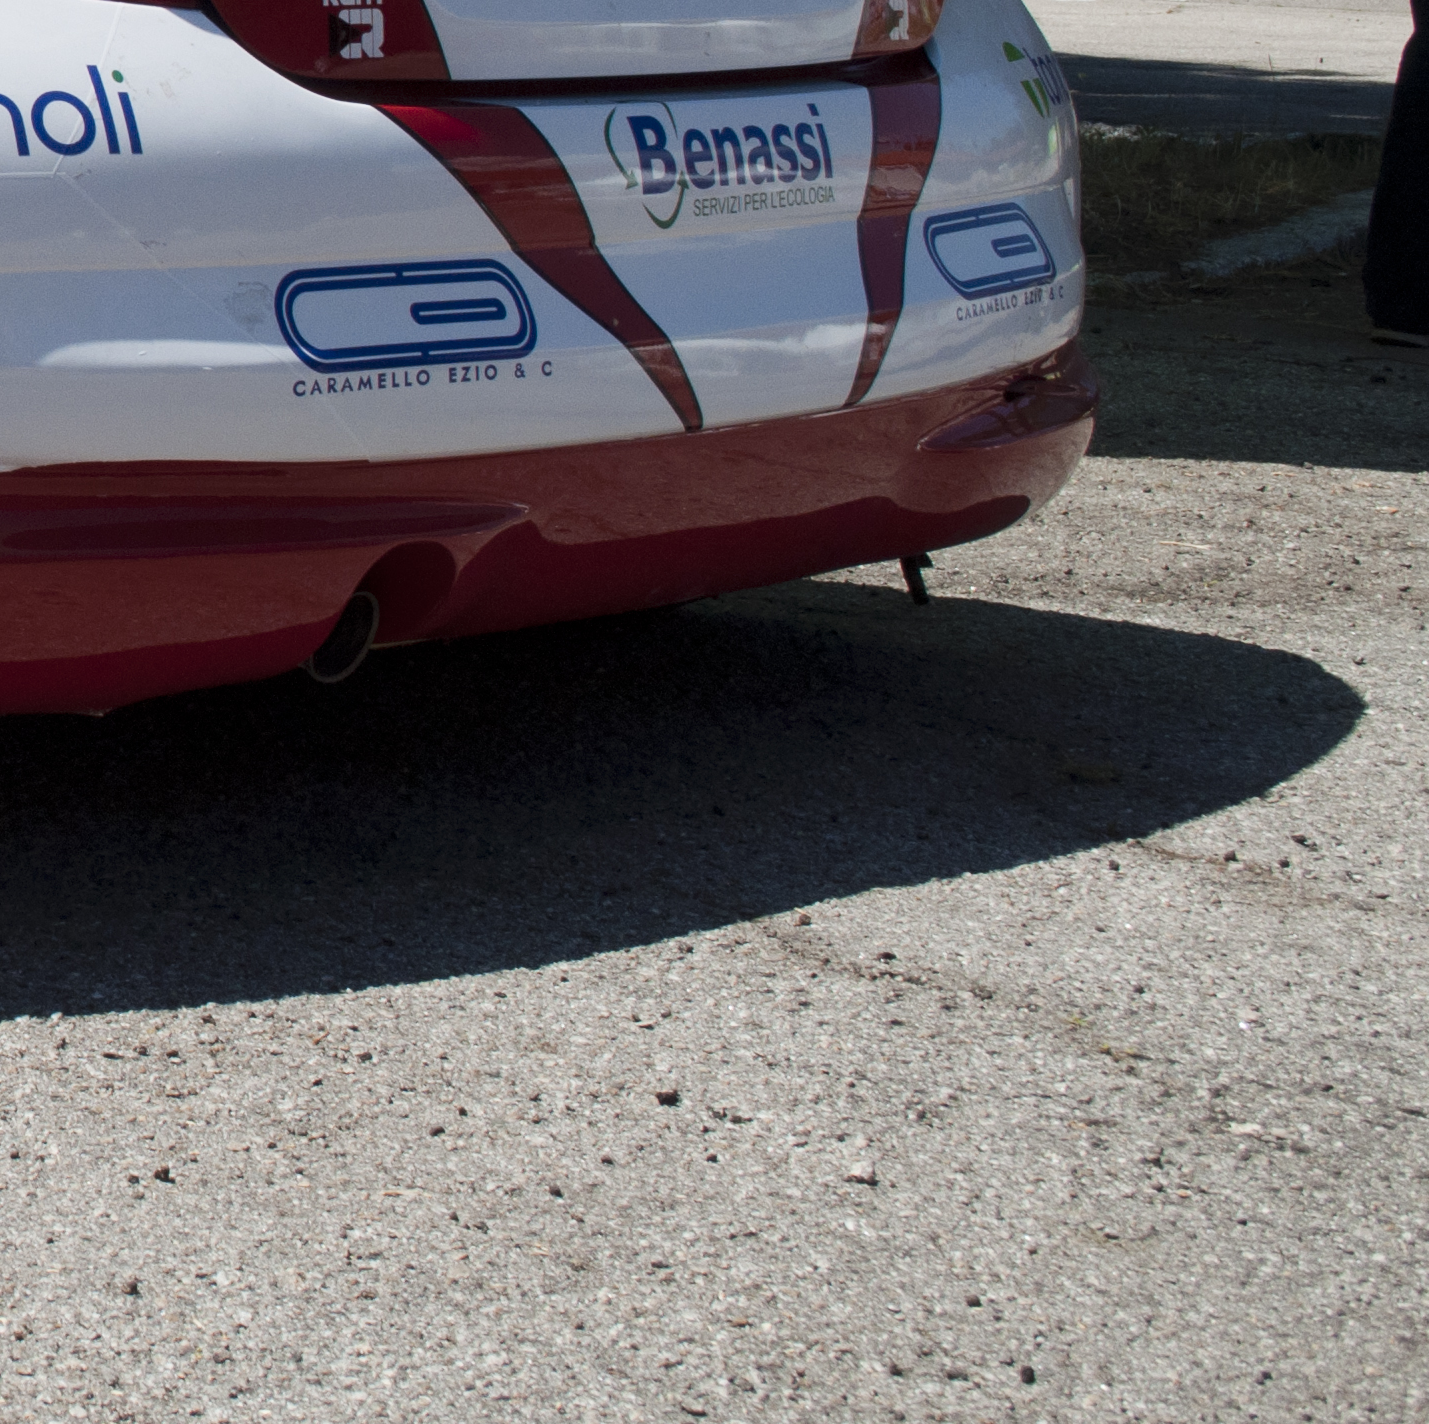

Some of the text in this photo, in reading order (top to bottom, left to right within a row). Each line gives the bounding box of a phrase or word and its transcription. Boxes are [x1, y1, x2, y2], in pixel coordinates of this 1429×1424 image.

[626, 104, 834, 196] Benassi
[692, 183, 836, 218] SERVIZI PER L'ECOLOGIA
[956, 293, 1018, 322] CARAMELLO
[292, 359, 554, 399] CARAMELLO EZIO & C
